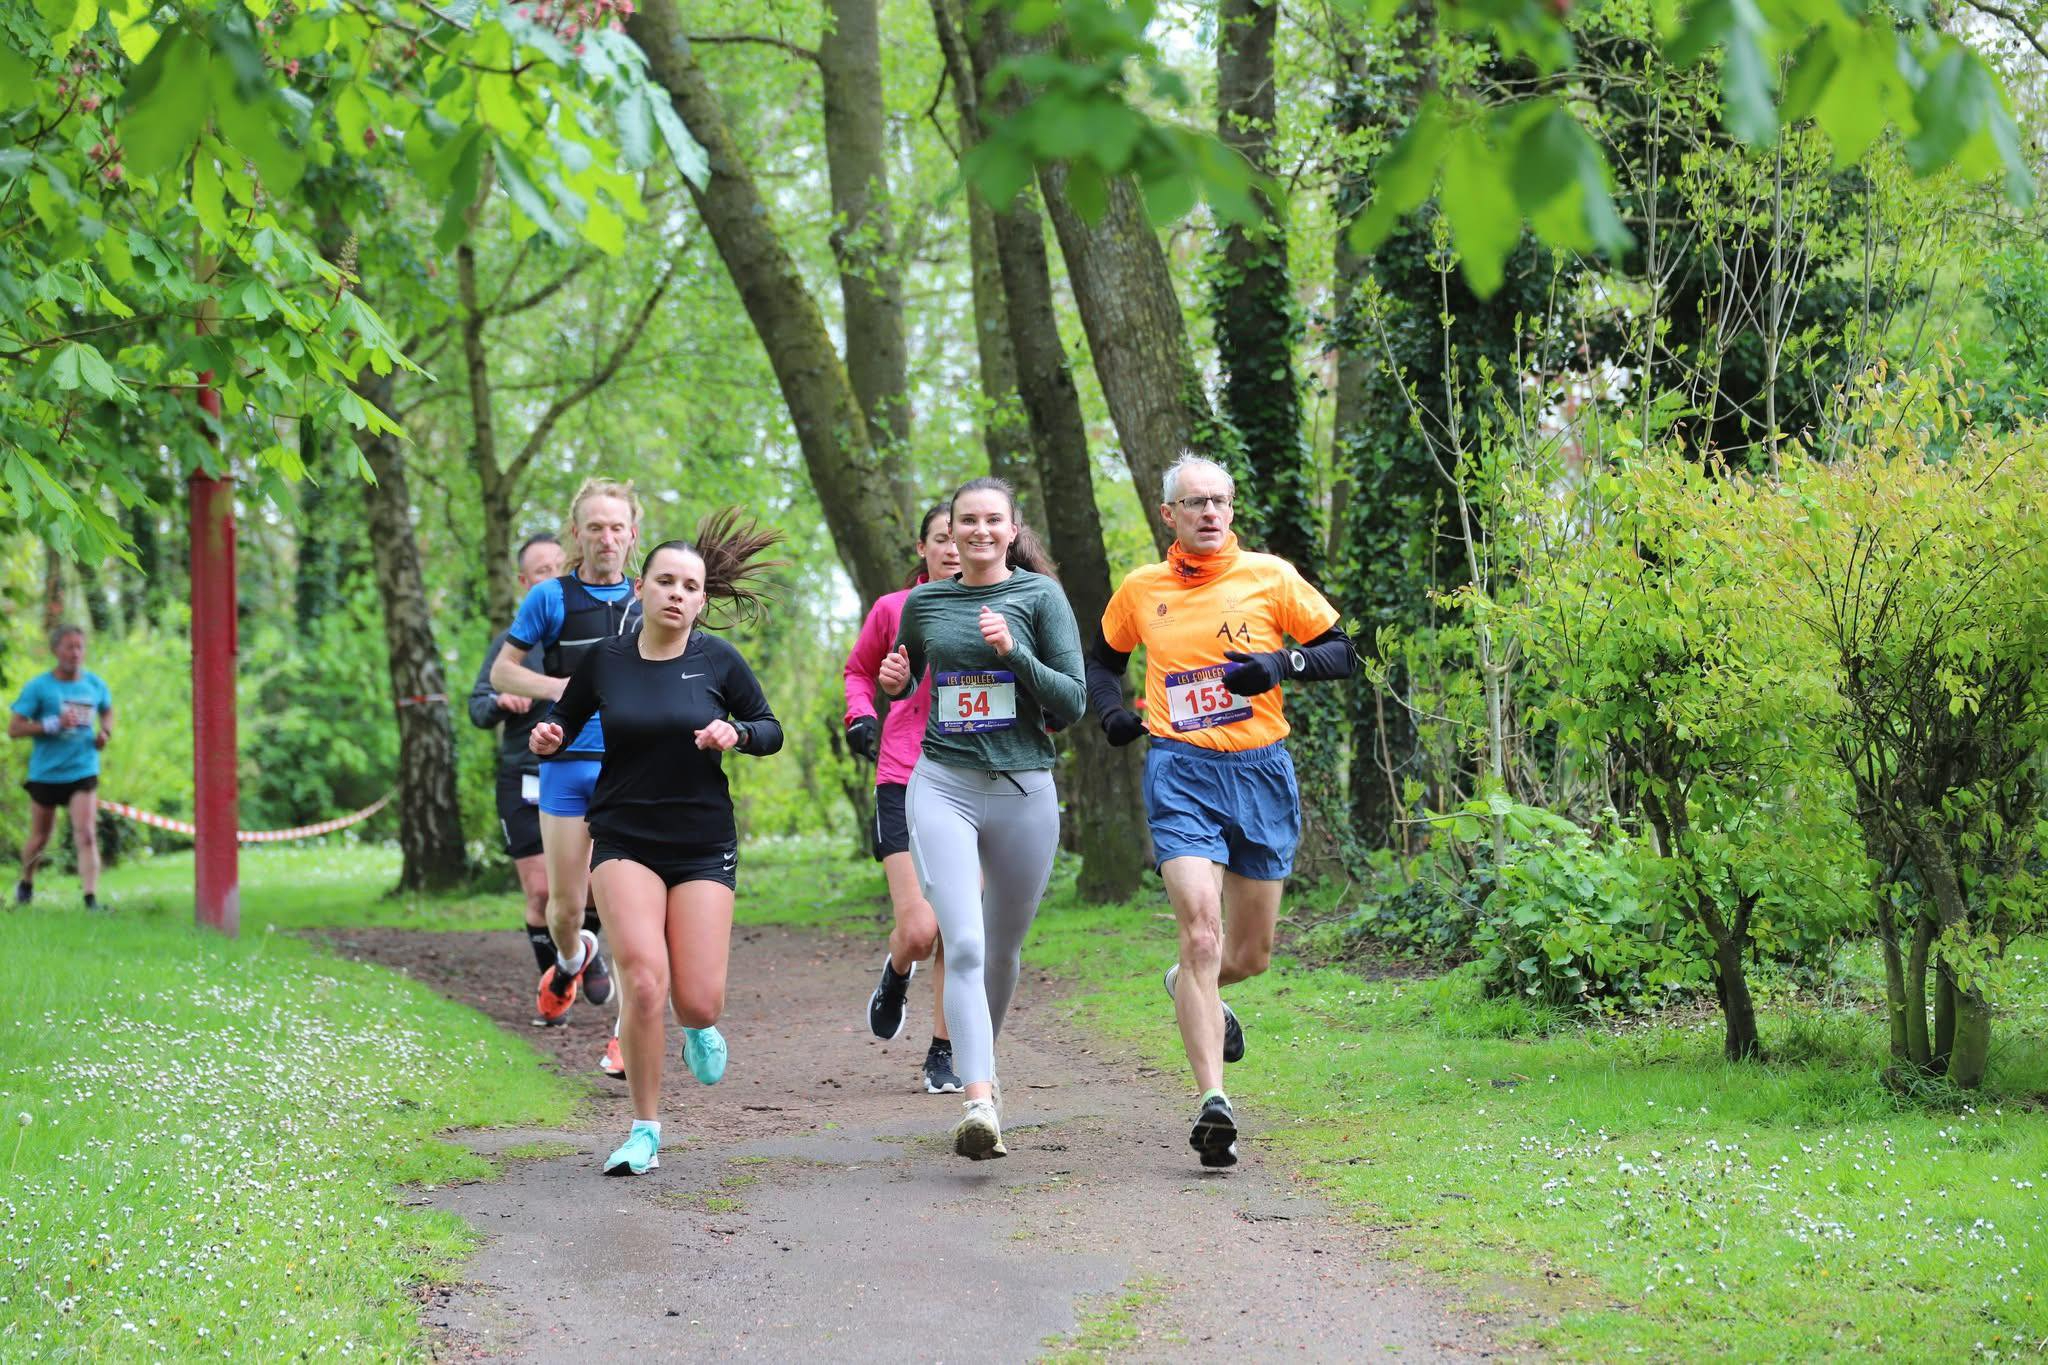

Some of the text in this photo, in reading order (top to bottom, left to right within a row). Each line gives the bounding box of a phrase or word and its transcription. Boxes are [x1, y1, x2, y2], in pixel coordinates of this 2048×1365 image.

[947, 675, 958, 686] LES
[1177, 674, 1190, 684] LES
[958, 690, 990, 718] 54
[1185, 683, 1233, 714] 153
